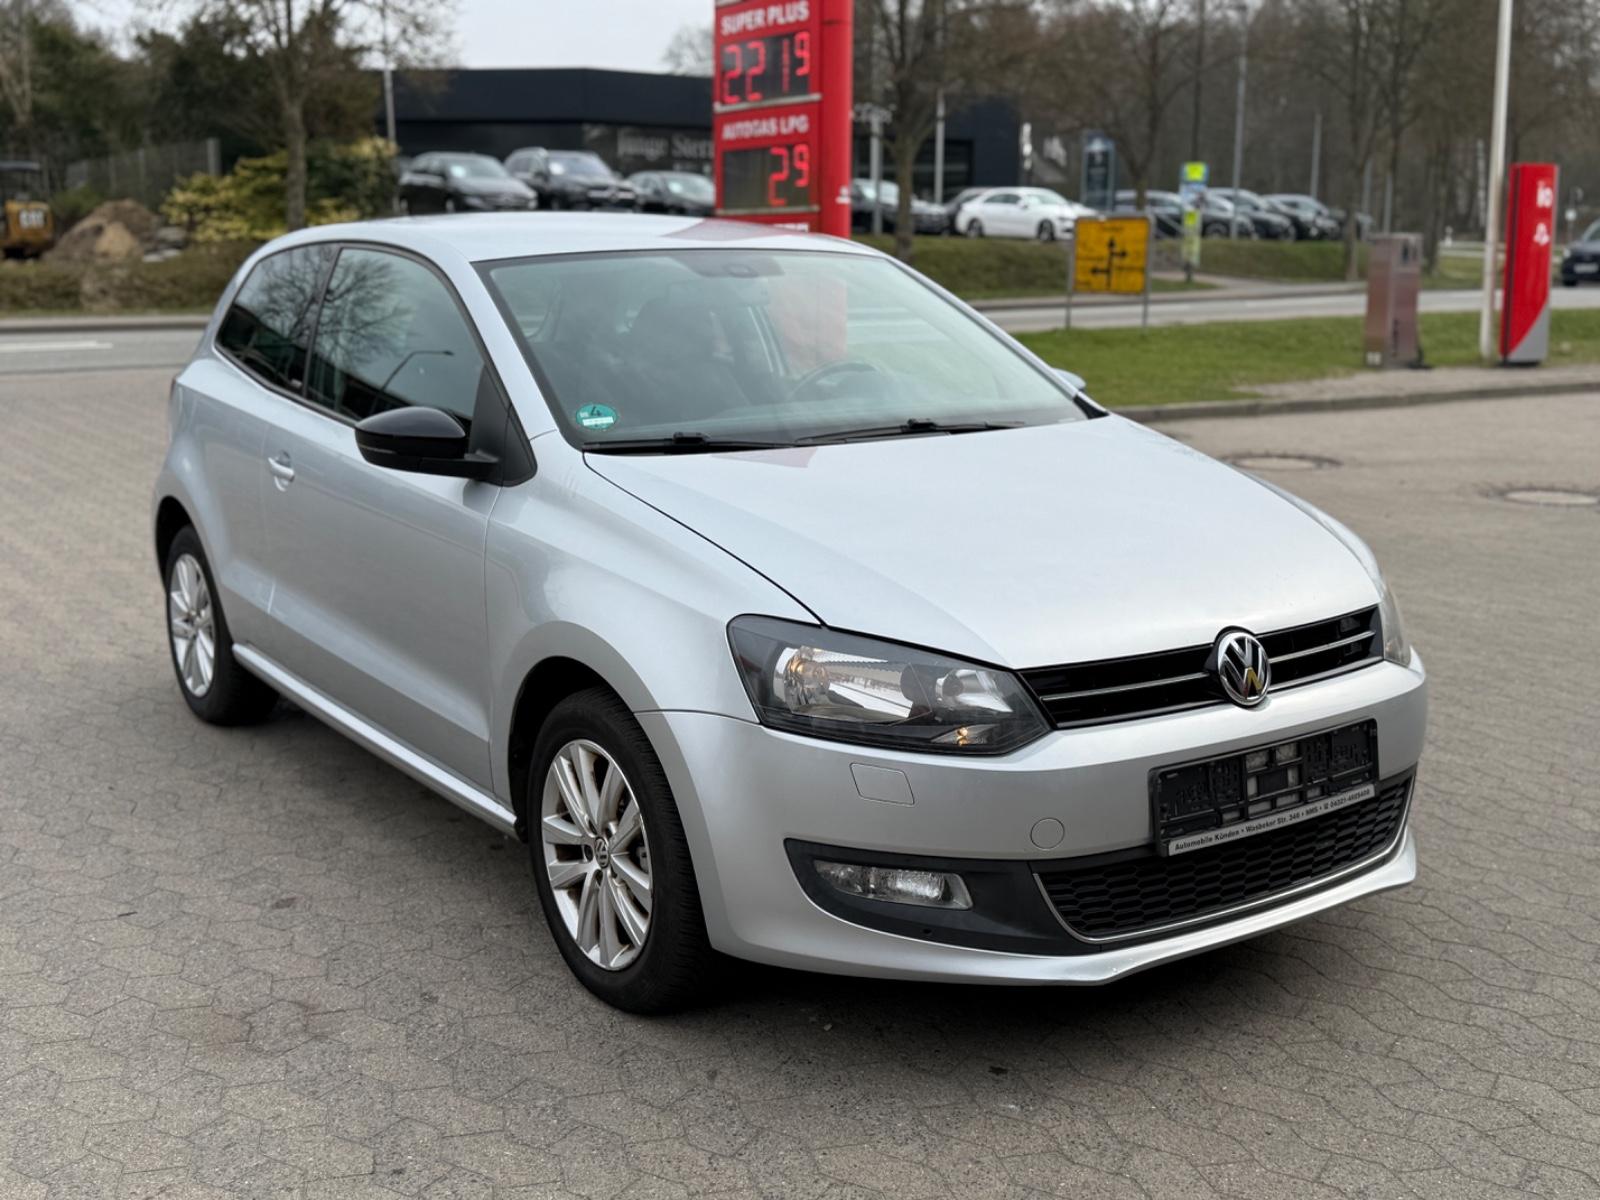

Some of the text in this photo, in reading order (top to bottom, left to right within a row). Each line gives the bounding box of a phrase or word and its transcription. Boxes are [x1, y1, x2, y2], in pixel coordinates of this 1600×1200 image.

[721, 0, 809, 36] SUPER PLUS
[722, 114, 809, 140] AUTOGAS LPG
[1175, 836, 1213, 850] Automobile
